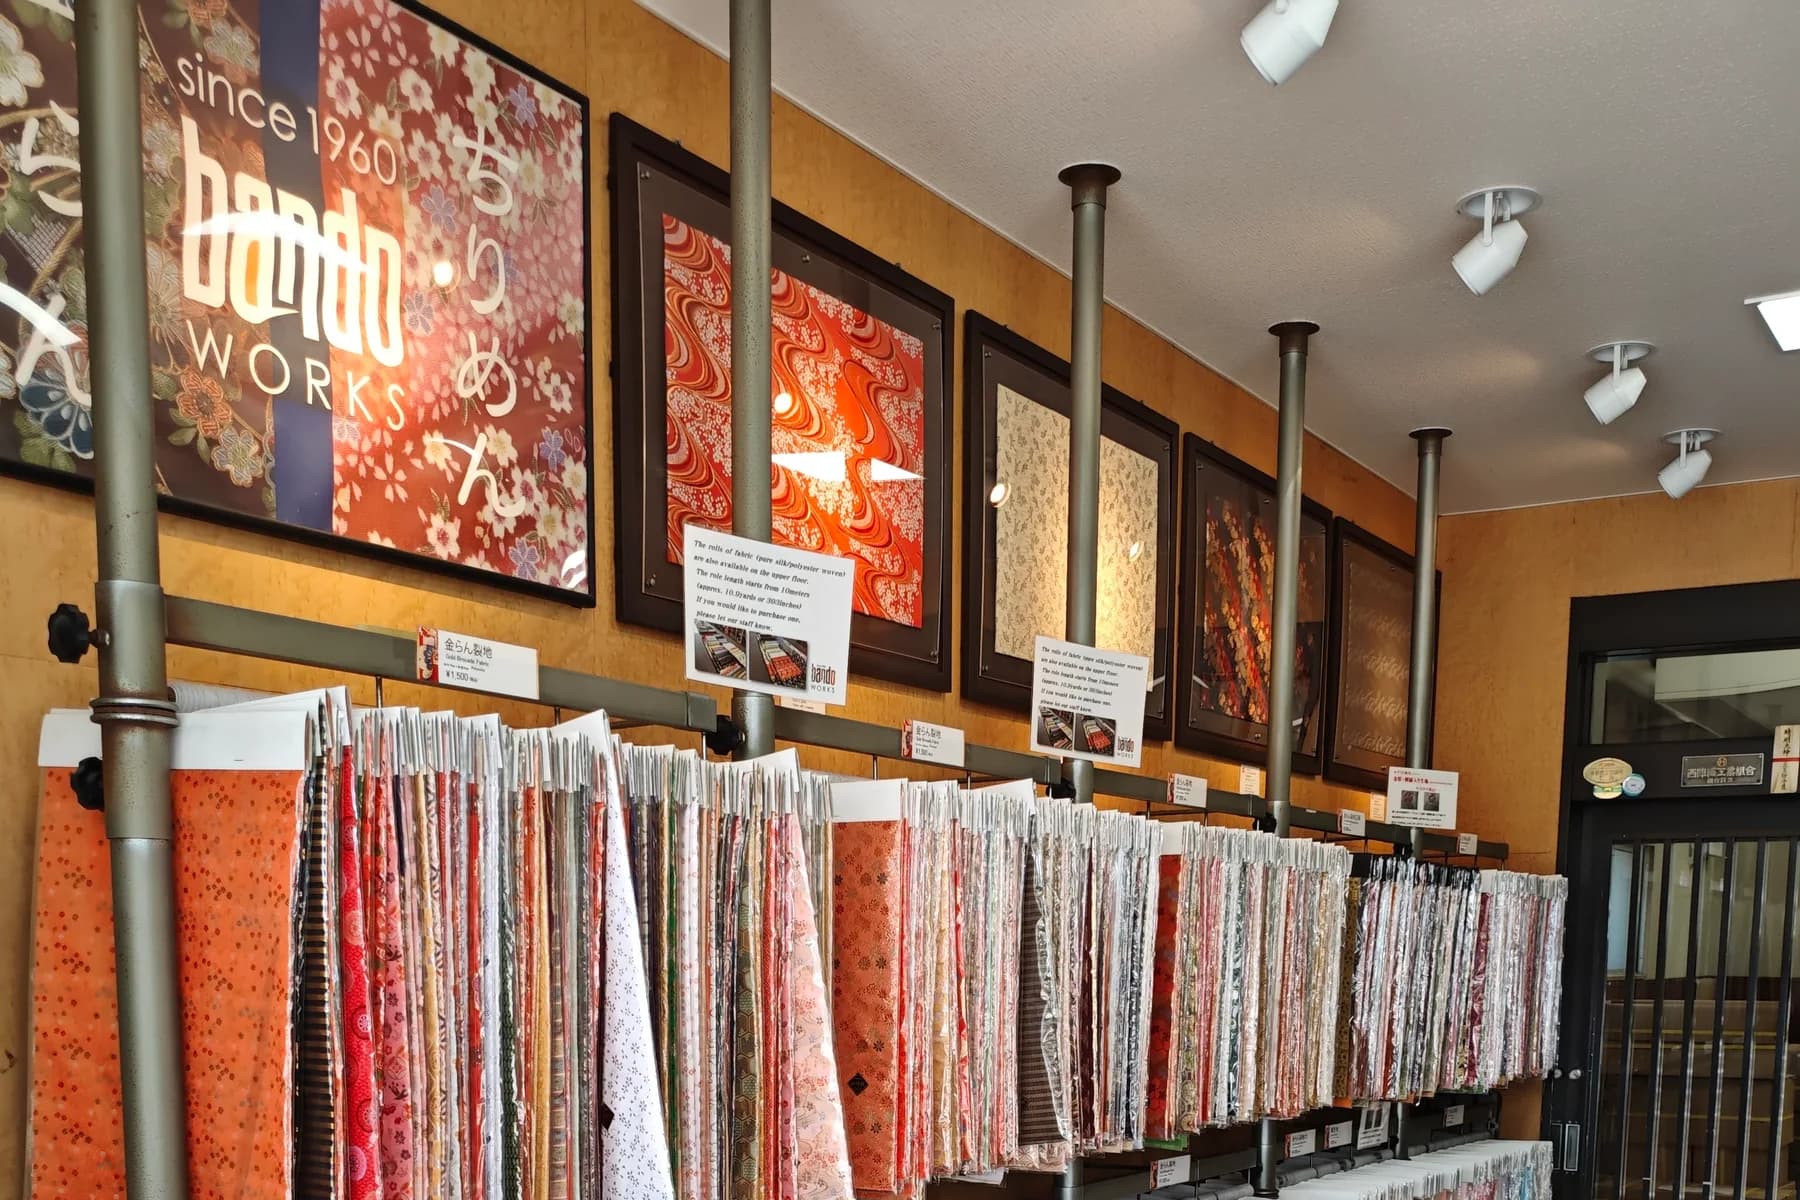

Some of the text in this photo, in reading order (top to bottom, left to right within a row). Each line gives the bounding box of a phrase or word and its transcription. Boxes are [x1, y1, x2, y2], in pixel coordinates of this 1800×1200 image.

[176, 54, 398, 186] since 1960
[180, 115, 404, 368] bando
[440, 127, 526, 517] ちりめん
[186, 318, 406, 431] WORKS
[694, 540, 705, 548] The
[708, 543, 722, 552] rolls
[734, 549, 752, 559] fabric
[697, 568, 707, 576] The
[709, 571, 722, 579] role
[724, 574, 743, 584] length
[745, 579, 762, 588] starts
[764, 583, 778, 591] from
[705, 556, 717, 565] also
[720, 559, 748, 571] available
[760, 568, 769, 576] the
[771, 572, 790, 581] upper
[696, 610, 715, 619] please
[717, 600, 735, 609] would
[737, 604, 748, 612] like
[758, 609, 785, 620] purchase
[444, 638, 493, 659] 金らん裂地
[446, 670, 468, 681] ¥1,500
[811, 664, 836, 686] bando
